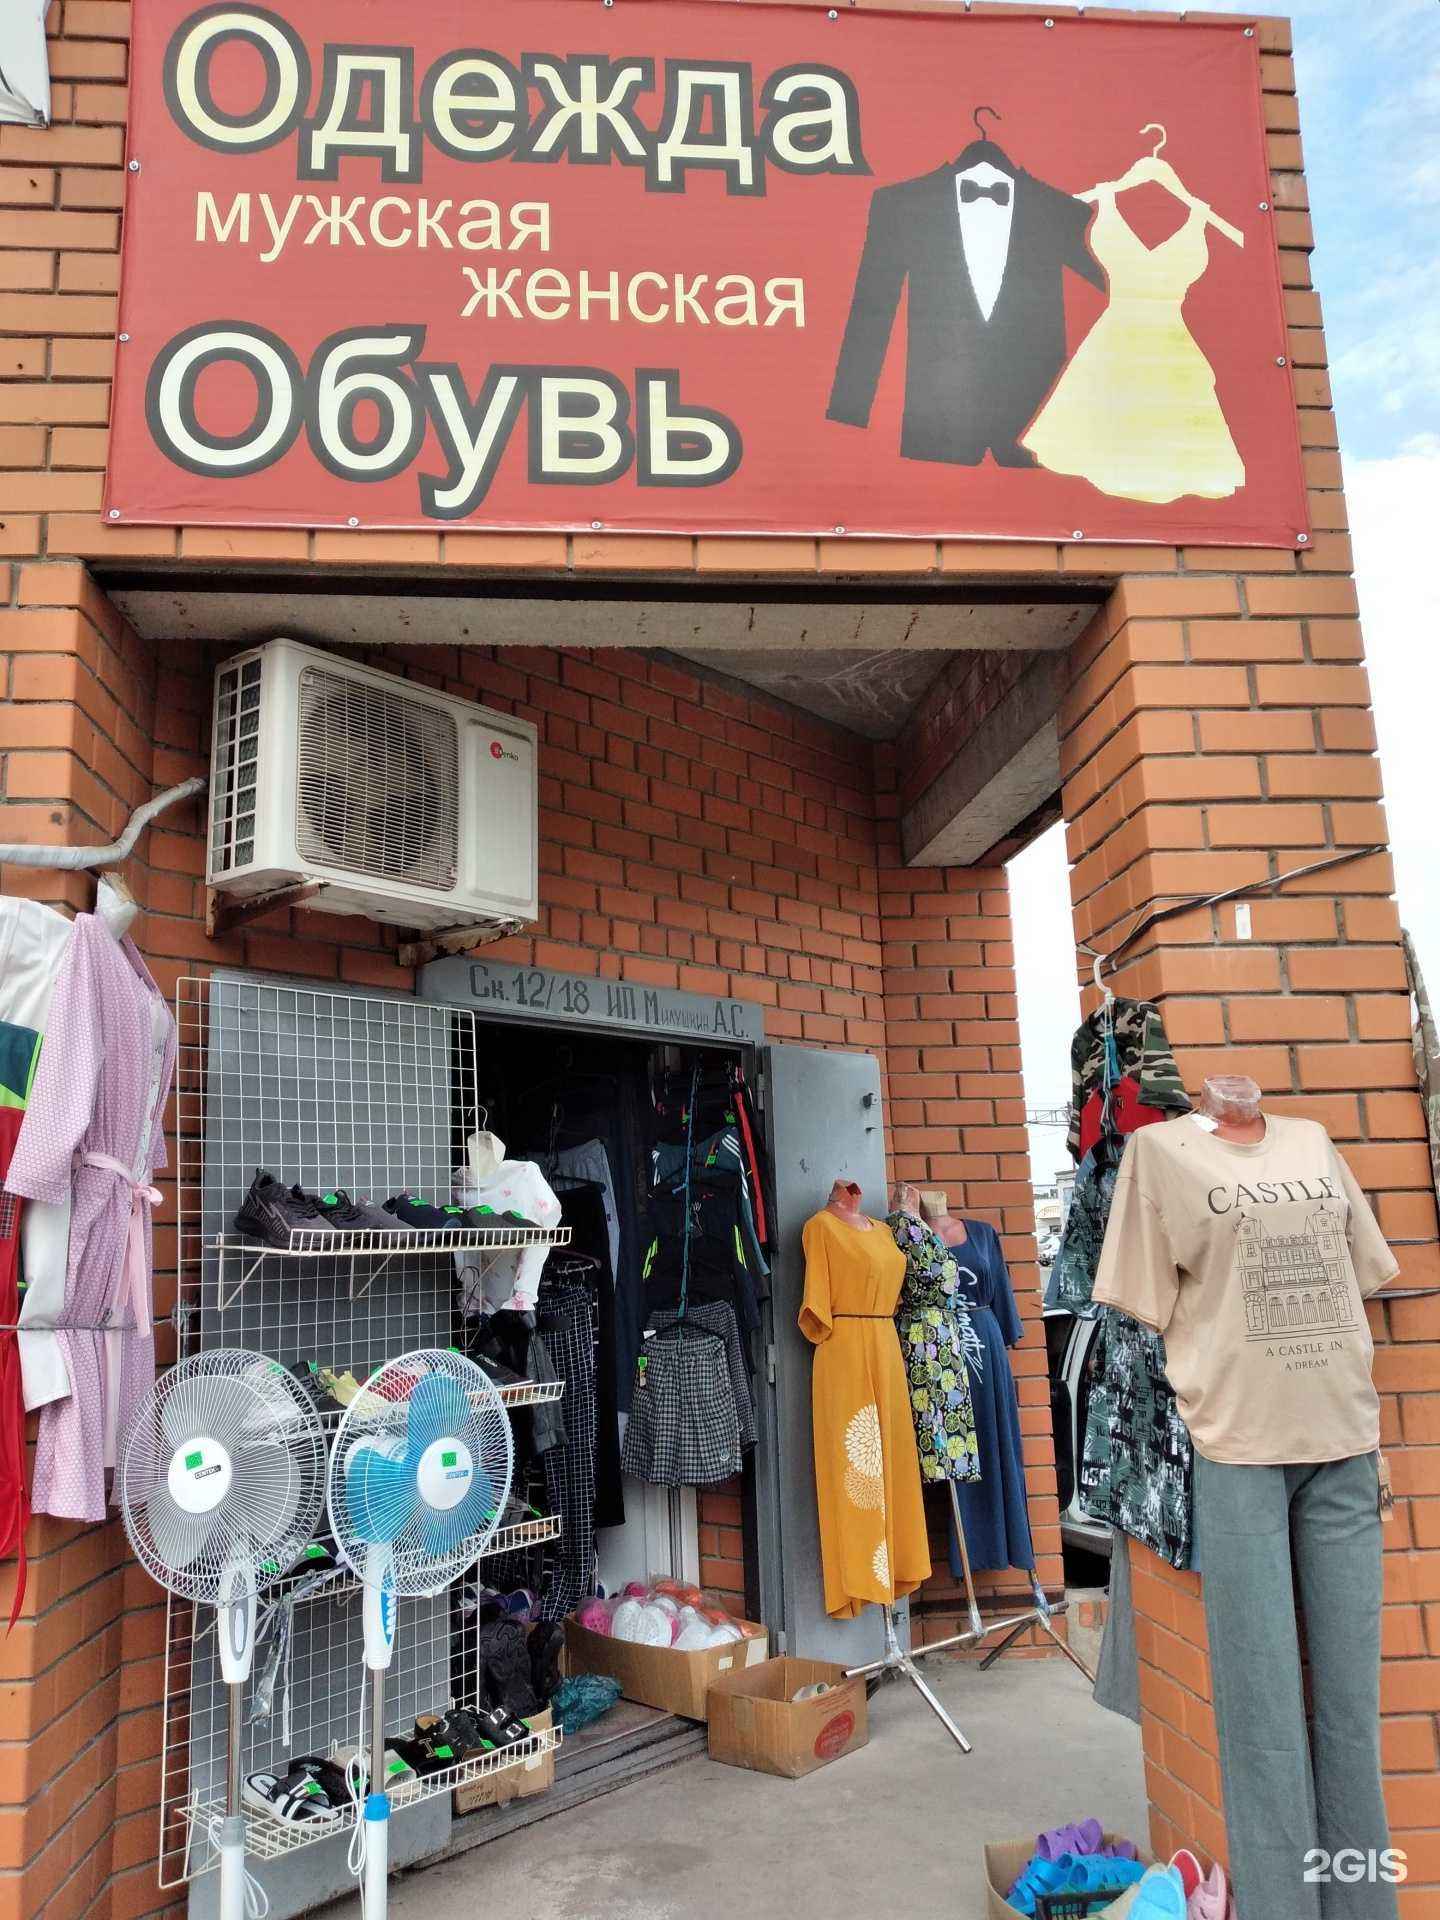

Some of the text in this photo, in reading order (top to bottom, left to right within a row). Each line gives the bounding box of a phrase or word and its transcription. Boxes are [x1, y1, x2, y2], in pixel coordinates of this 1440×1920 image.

[163, 3, 873, 196] Одежда
[194, 191, 551, 263] мужская
[461, 266, 806, 328] женская
[146, 319, 744, 519] Обувь
[607, 984, 636, 1020] ИП
[1207, 1176, 1341, 1215] CASTLE
[1265, 1339, 1343, 1357] A CASTLE IN
[1295, 1358, 1329, 1370] DREAM
